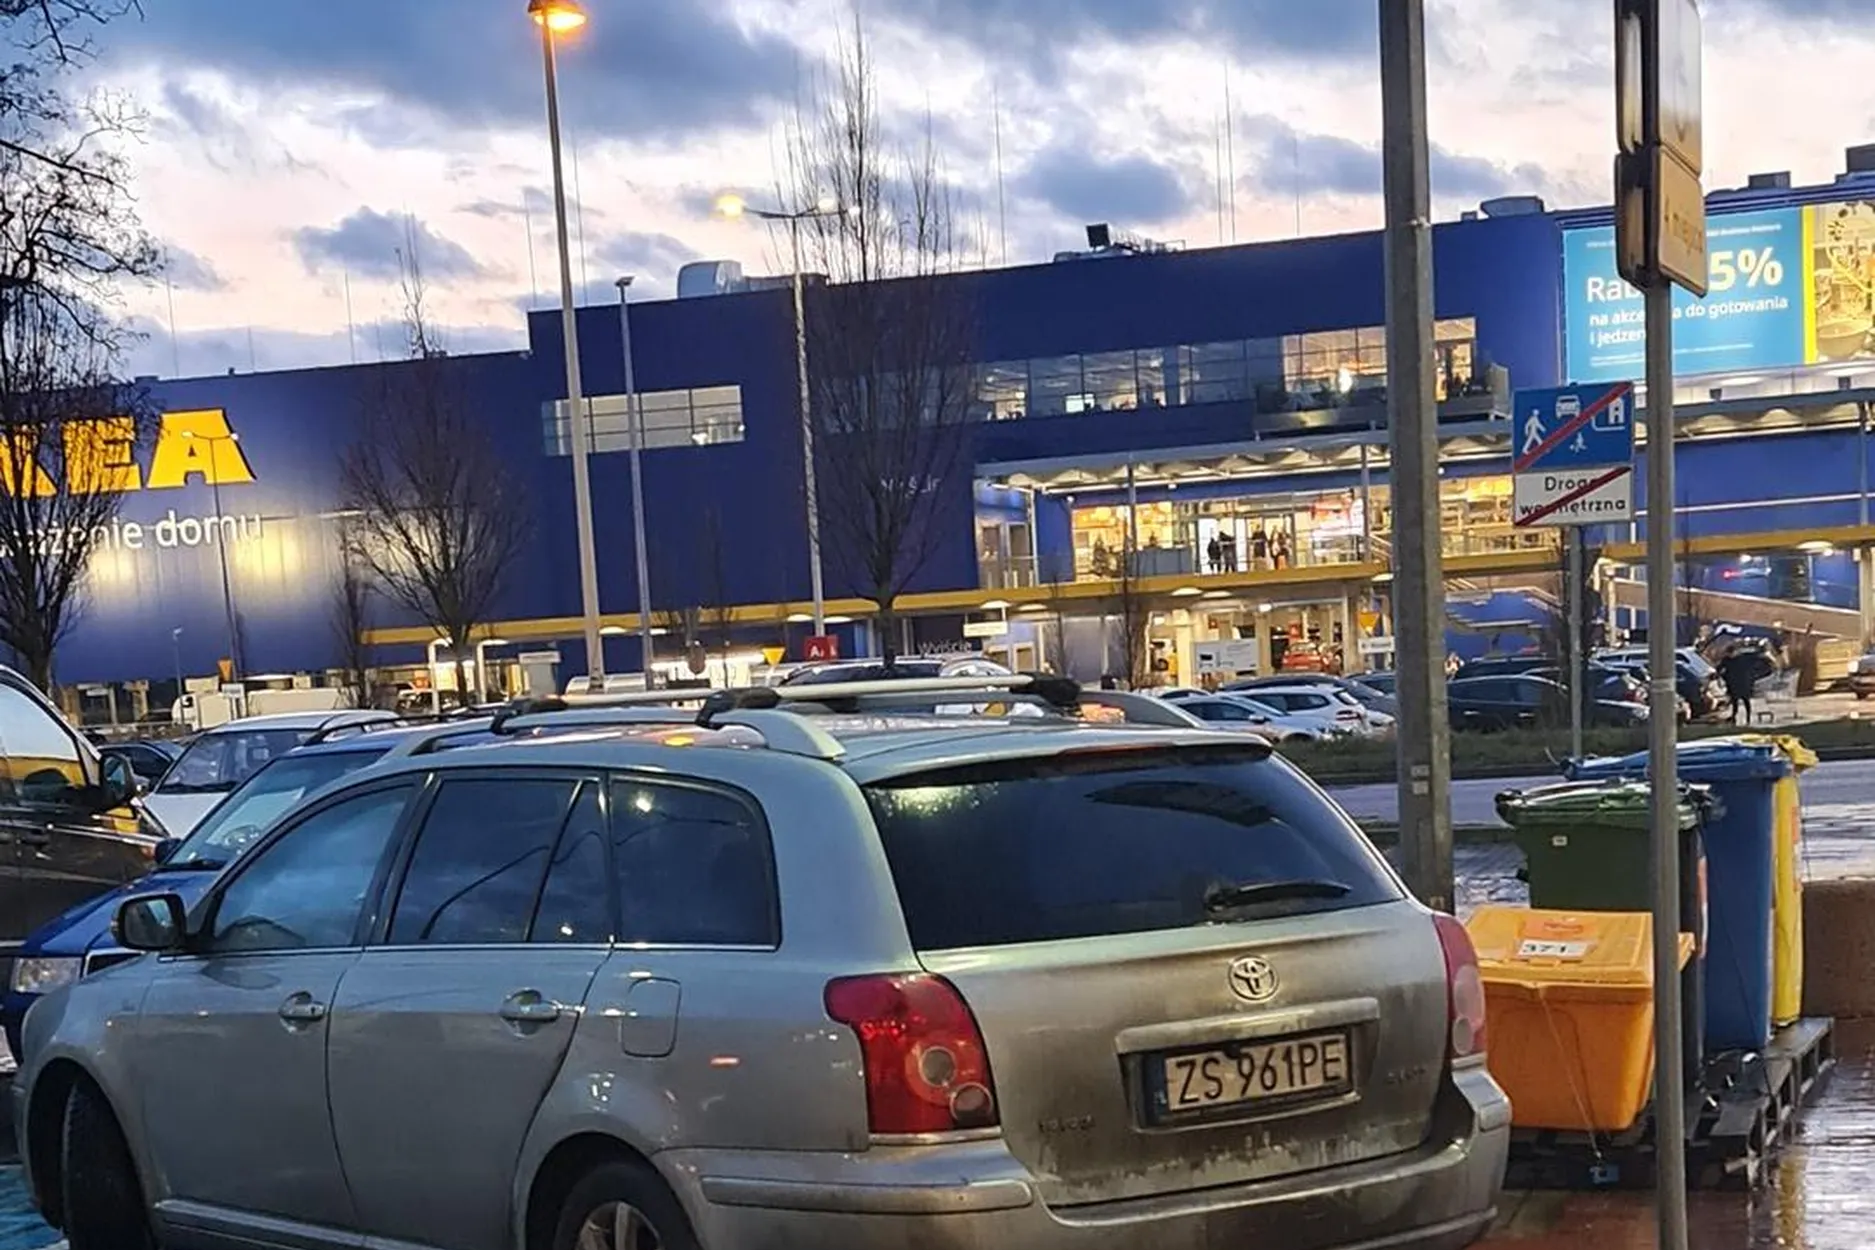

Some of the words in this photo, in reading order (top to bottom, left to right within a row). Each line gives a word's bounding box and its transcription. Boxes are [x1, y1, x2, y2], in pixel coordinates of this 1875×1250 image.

[1708, 246, 1784, 292] 5%
[1589, 313, 1608, 326] na
[1684, 302, 1706, 318] do
[1708, 295, 1789, 320] gotowania
[1596, 325, 1646, 348] jedzen
[155, 509, 264, 547] domu
[1175, 1057, 1223, 1104] ZS
[1236, 1038, 1342, 1097] 961PE
